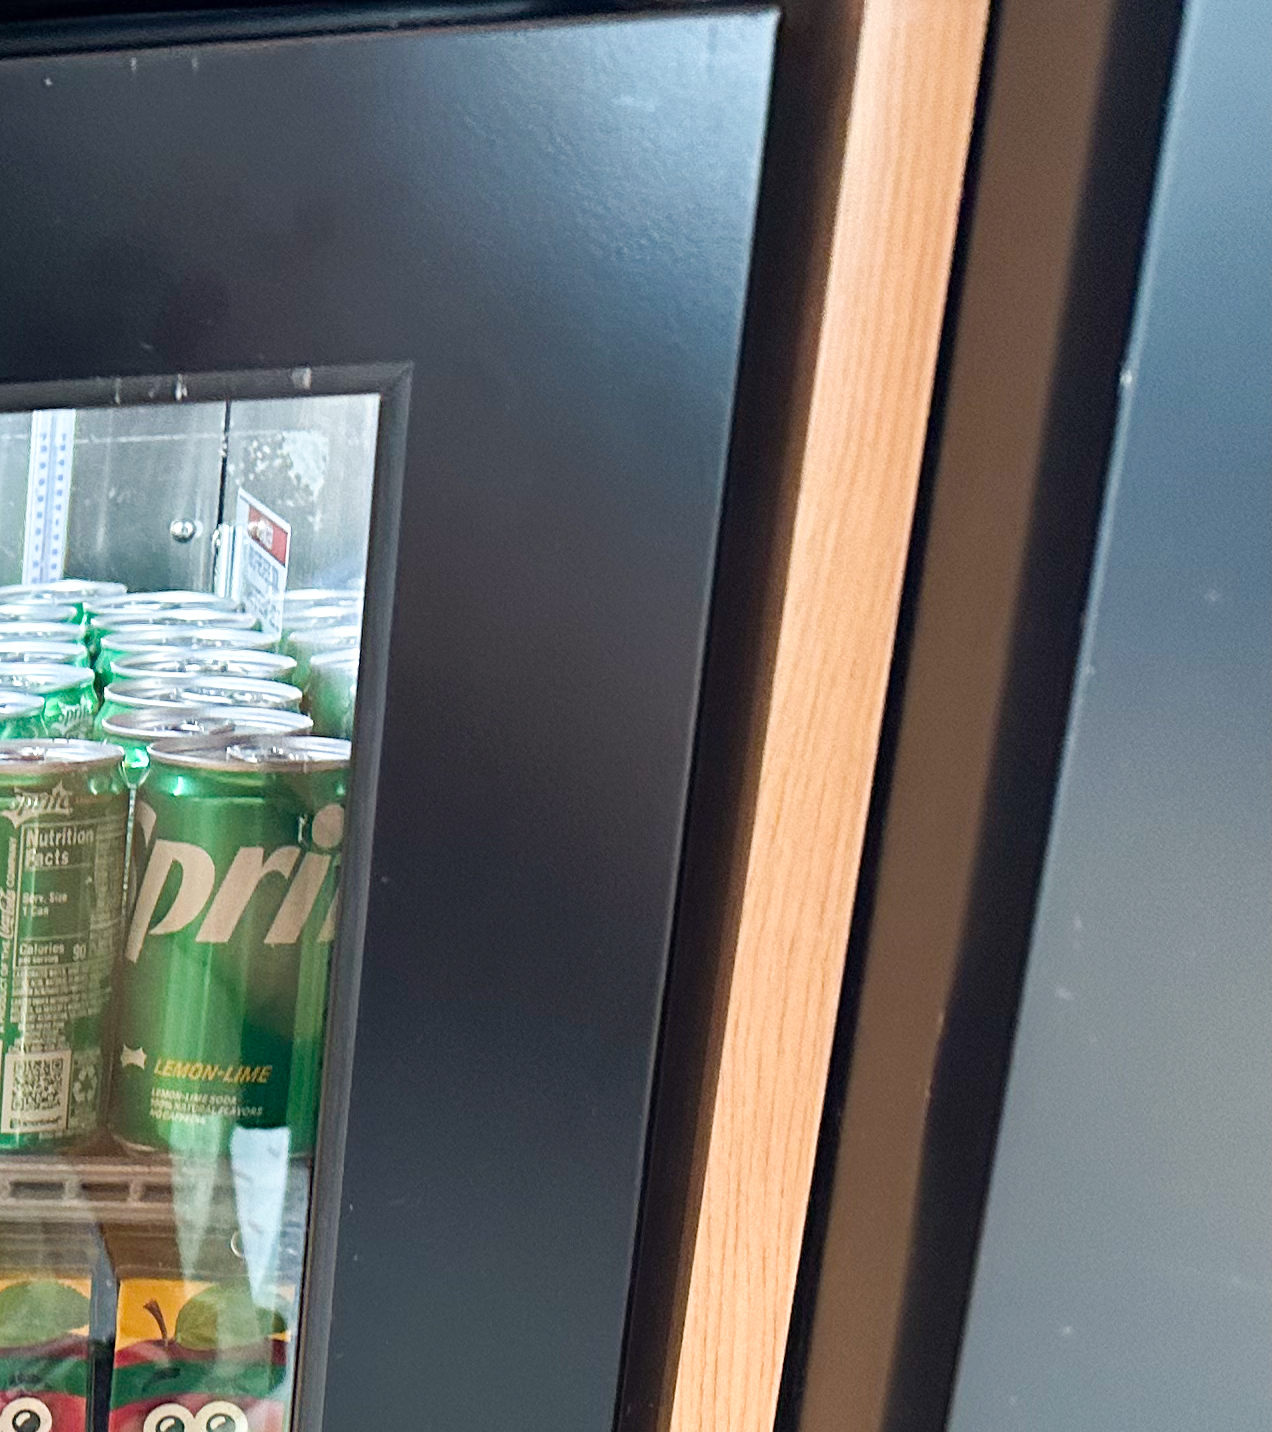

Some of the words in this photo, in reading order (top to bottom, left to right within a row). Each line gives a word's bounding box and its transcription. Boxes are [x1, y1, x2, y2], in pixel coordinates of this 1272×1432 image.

[25, 826, 95, 848] Nutrition
[25, 849, 70, 868] Facts
[22, 891, 47, 904] Serv.
[49, 892, 68, 903] Size
[31, 906, 49, 917] Can
[19, 942, 65, 956] Calories
[72, 943, 87, 960] 90
